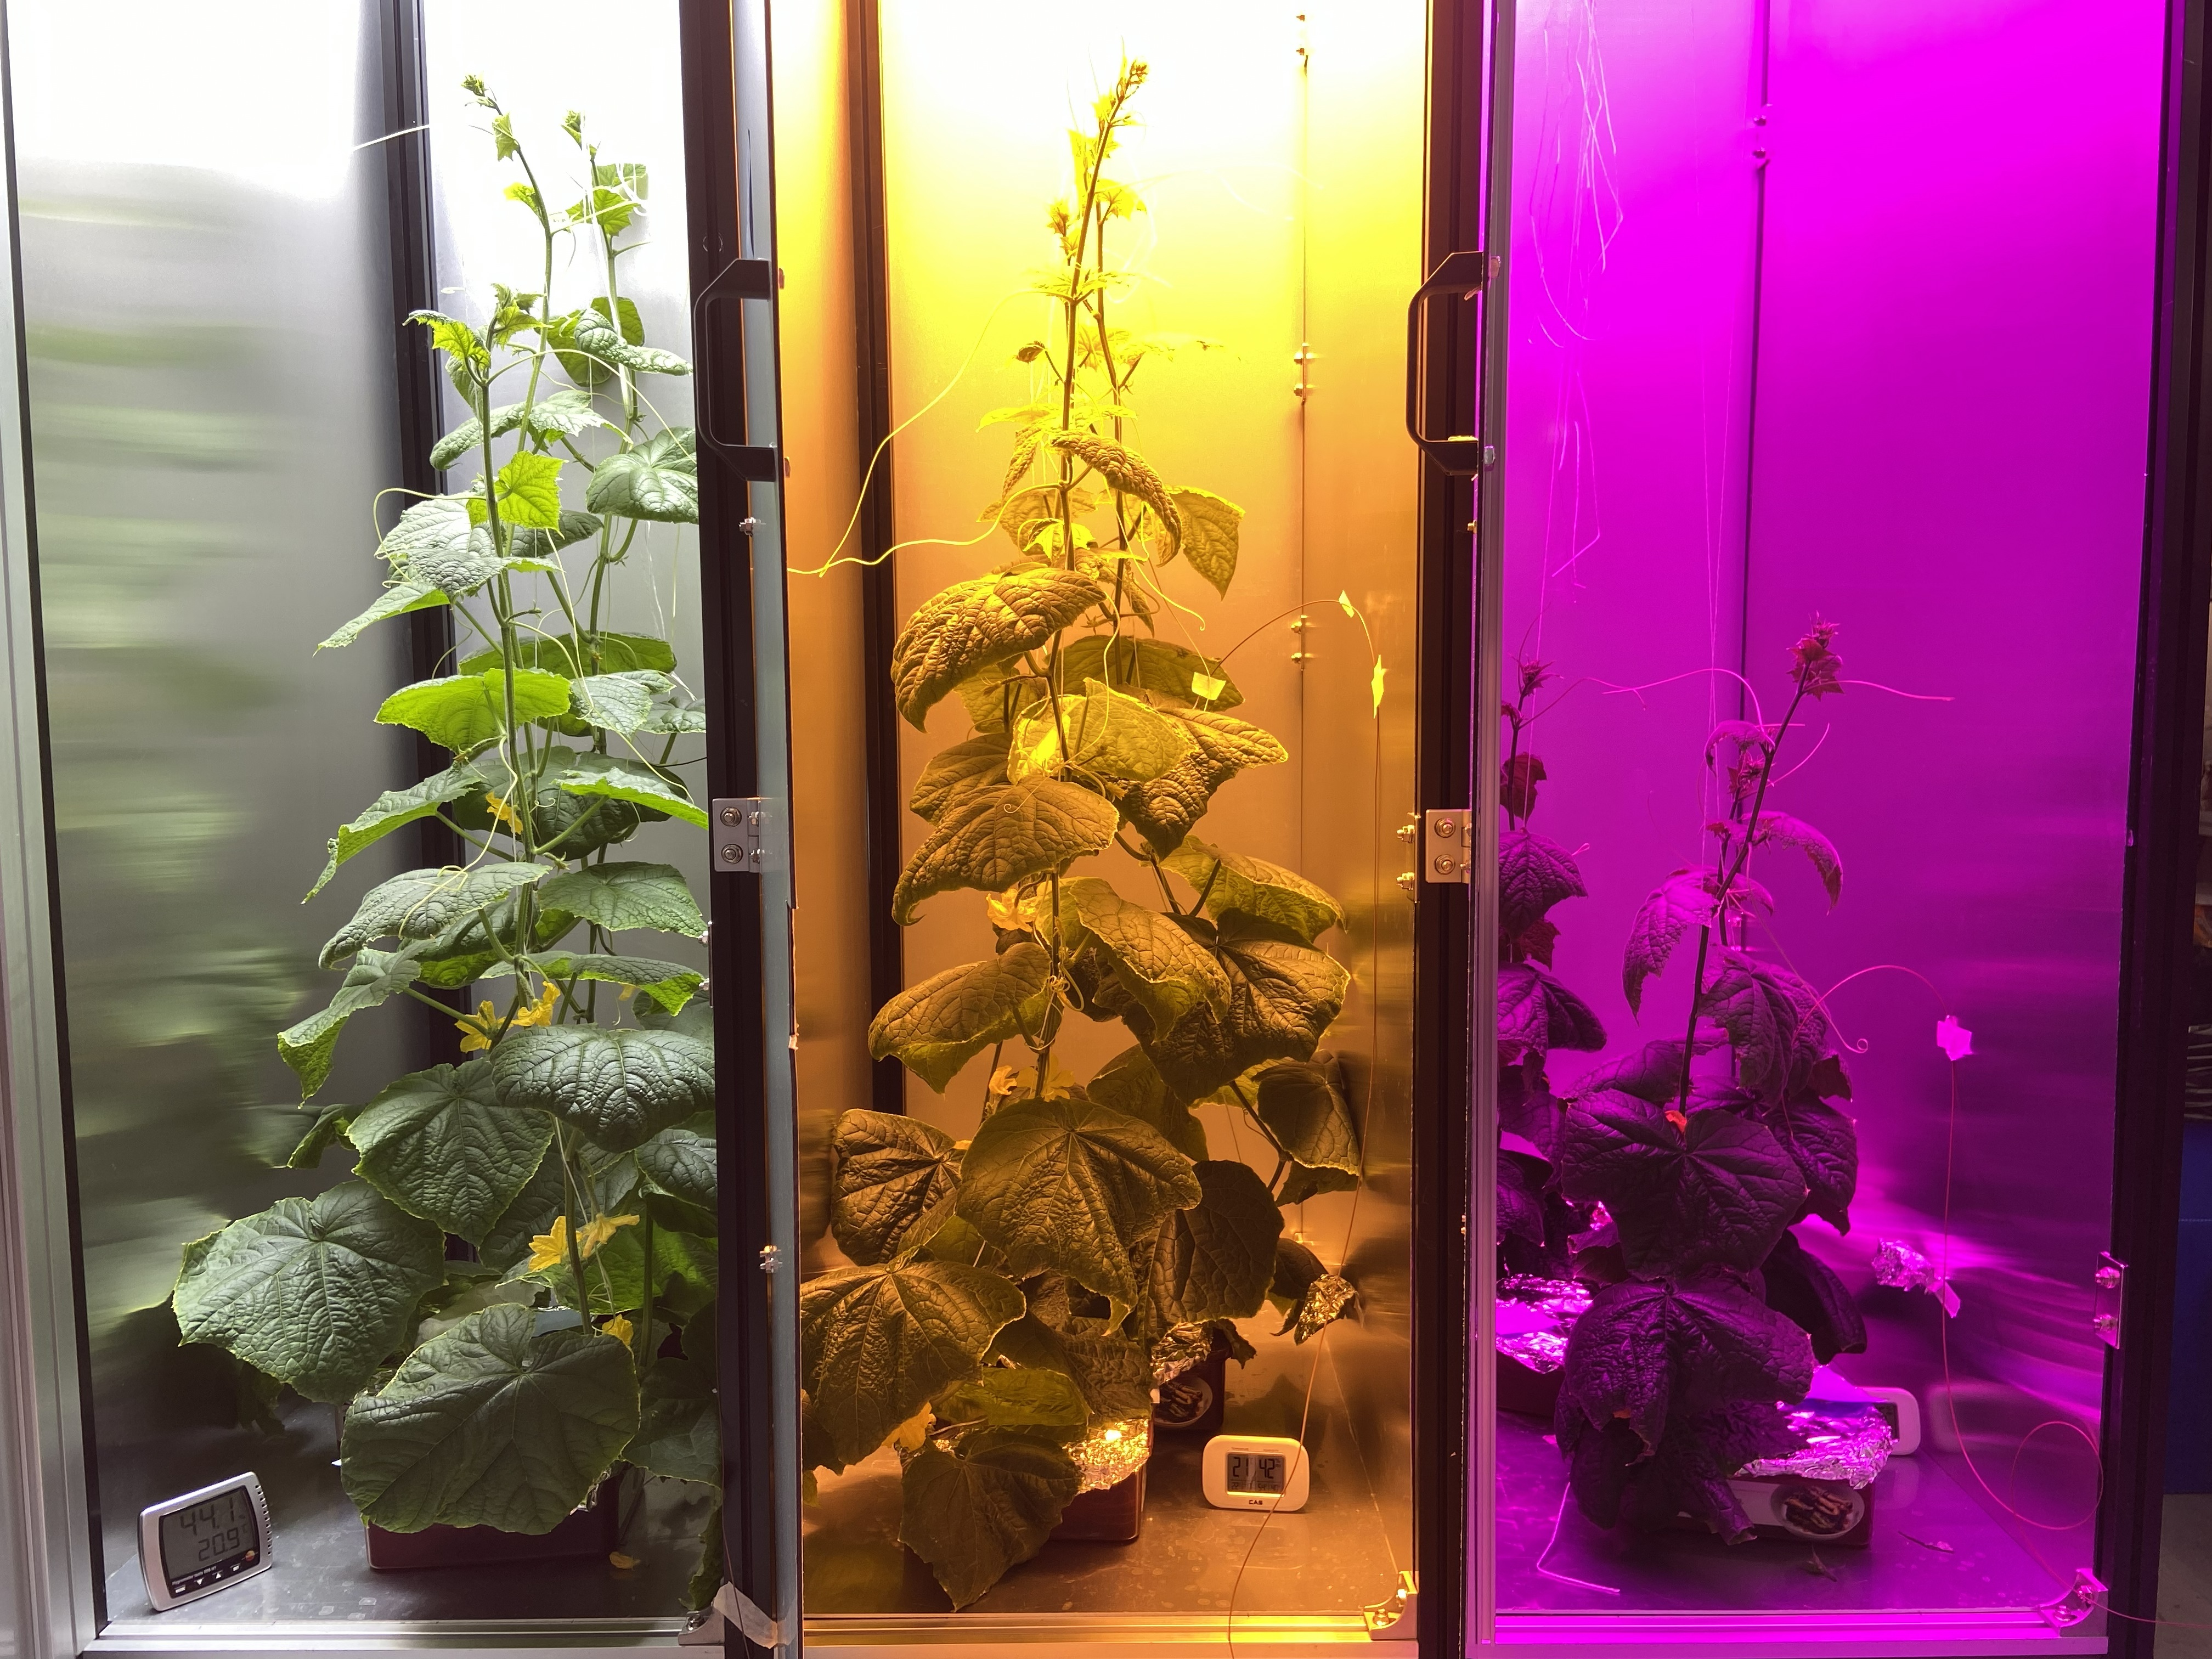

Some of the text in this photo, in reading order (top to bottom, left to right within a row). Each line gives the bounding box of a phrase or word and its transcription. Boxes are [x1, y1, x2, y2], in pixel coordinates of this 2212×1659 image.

[1232, 1457, 1249, 1477] 21
[1259, 1458, 1275, 1479] 42
[180, 1497, 235, 1536] 44.1
[198, 1527, 240, 1561] 20.9
